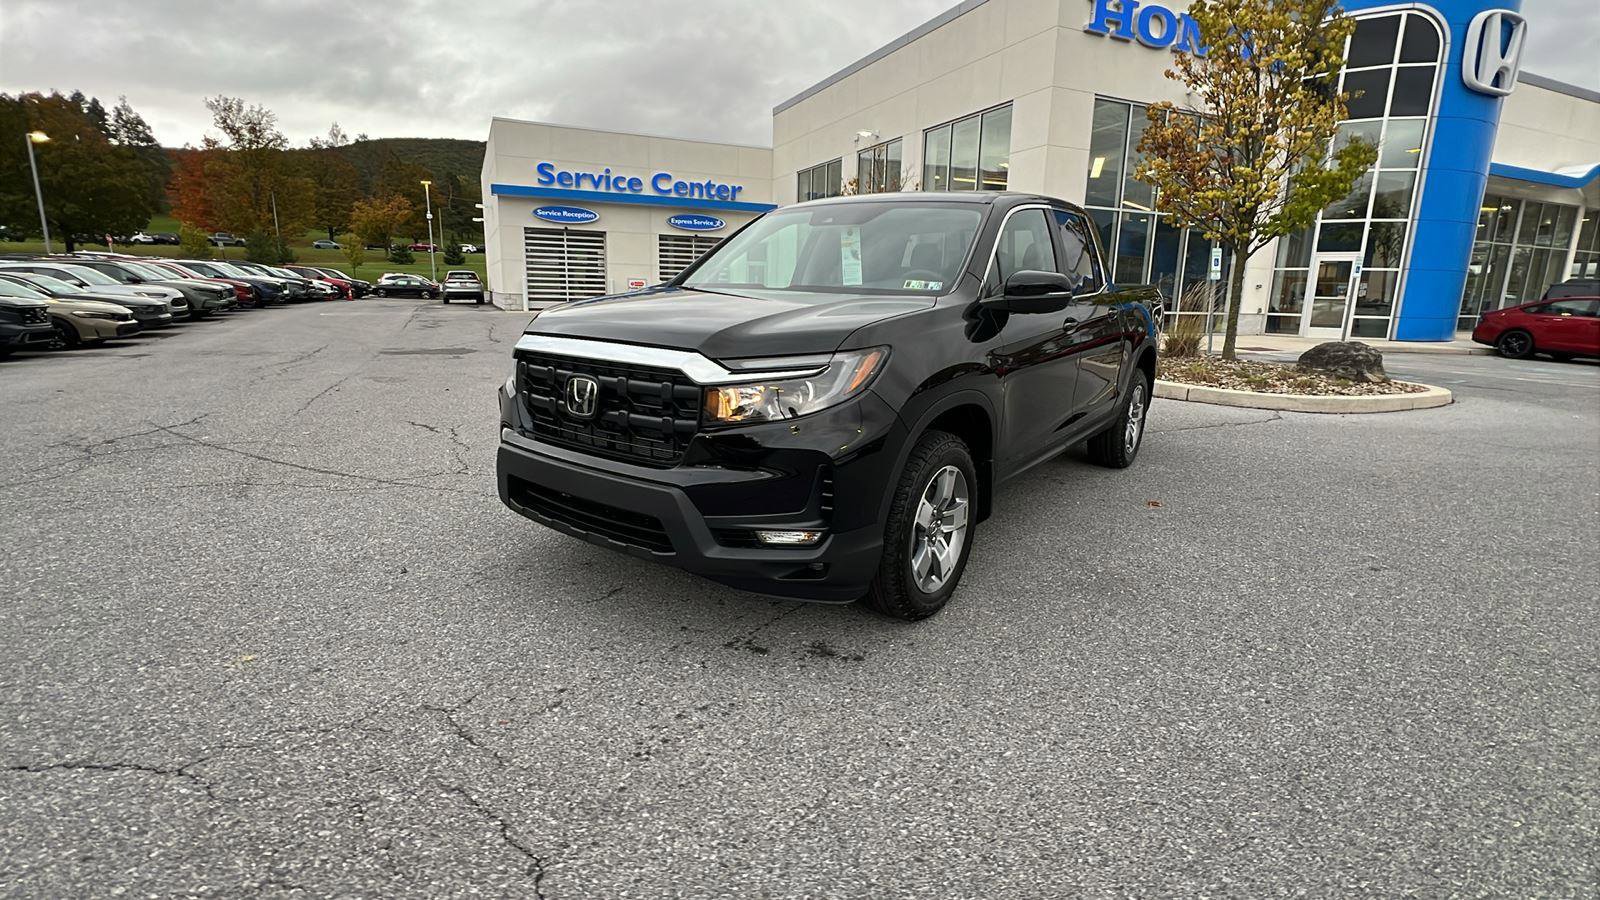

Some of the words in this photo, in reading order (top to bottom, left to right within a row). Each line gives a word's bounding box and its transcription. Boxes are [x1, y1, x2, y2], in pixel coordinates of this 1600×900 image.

[1085, 0, 1254, 58] HON
[536, 162, 643, 193] Service
[651, 172, 743, 201] Center
[536, 208, 562, 217] Service
[562, 210, 595, 219] Reception
[670, 217, 693, 225] Express
[693, 218, 714, 226] Service
